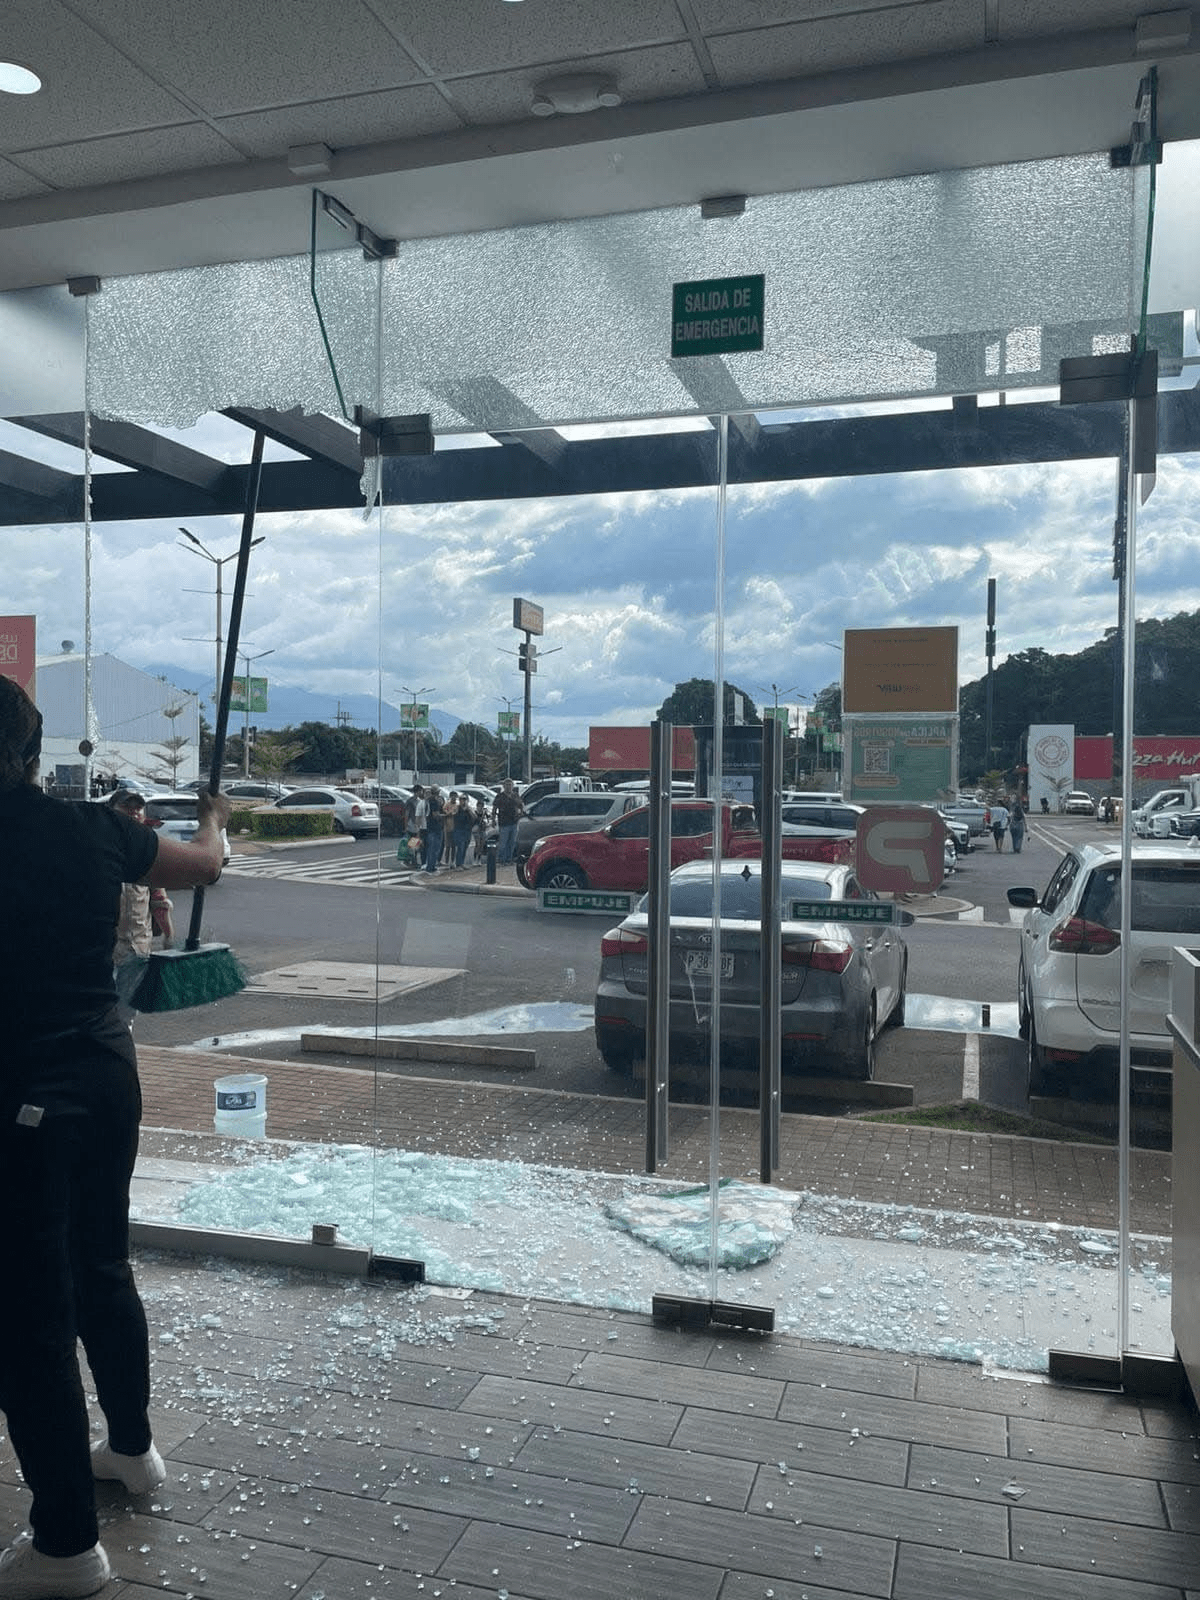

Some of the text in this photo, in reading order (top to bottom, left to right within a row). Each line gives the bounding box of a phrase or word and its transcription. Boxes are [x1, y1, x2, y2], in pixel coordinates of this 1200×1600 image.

[685, 287, 752, 313] SALIDA DE
[675, 314, 760, 341] EMERGENCIA
[547, 894, 629, 909] EMPUJE
[797, 904, 890, 919] EMPUJE
